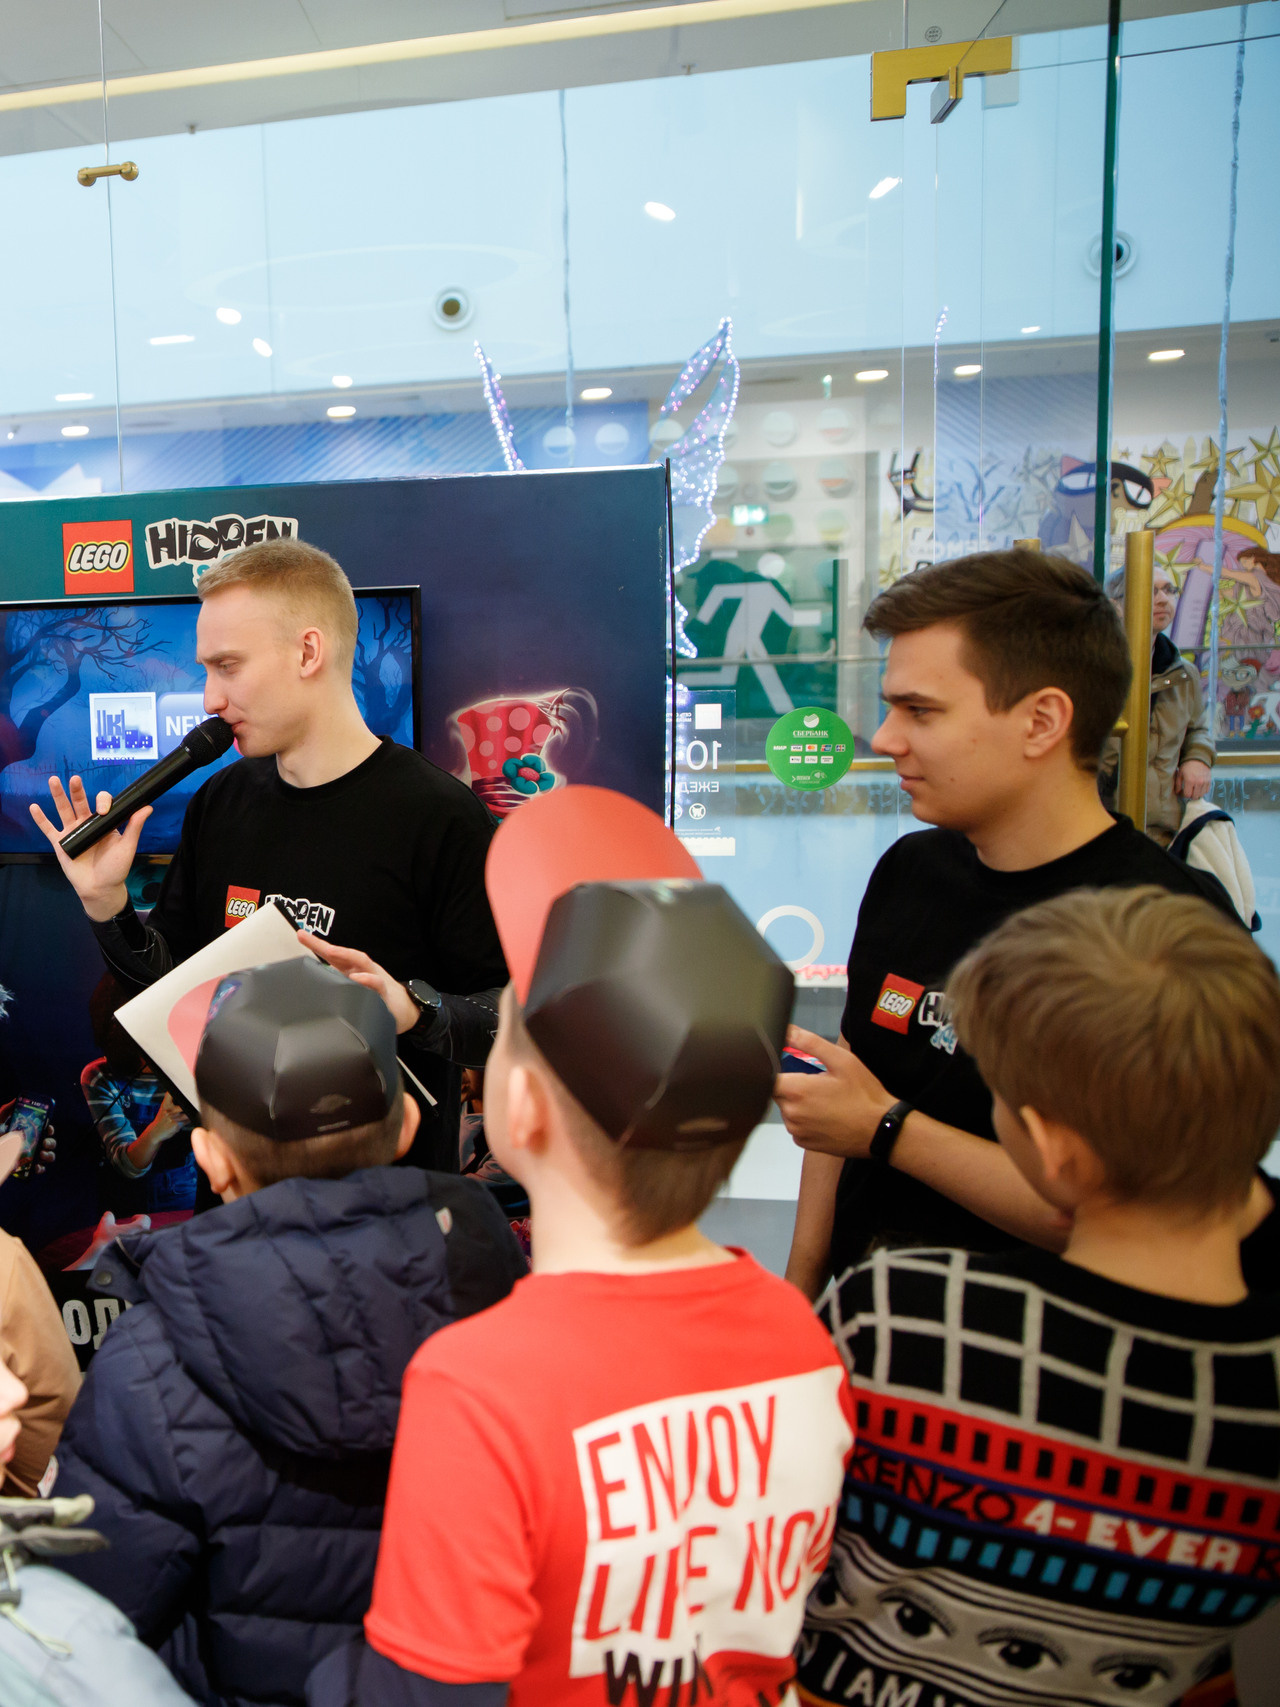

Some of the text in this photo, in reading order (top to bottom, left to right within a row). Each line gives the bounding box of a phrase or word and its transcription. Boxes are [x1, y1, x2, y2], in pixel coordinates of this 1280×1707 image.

[68, 542, 130, 573] LEGO
[227, 898, 258, 918] LEGO
[878, 990, 914, 1017] LEGO
[586, 1395, 776, 1541] ENJOY
[848, 1451, 1017, 1524] KENZO
[583, 1525, 718, 1641] LIFE
